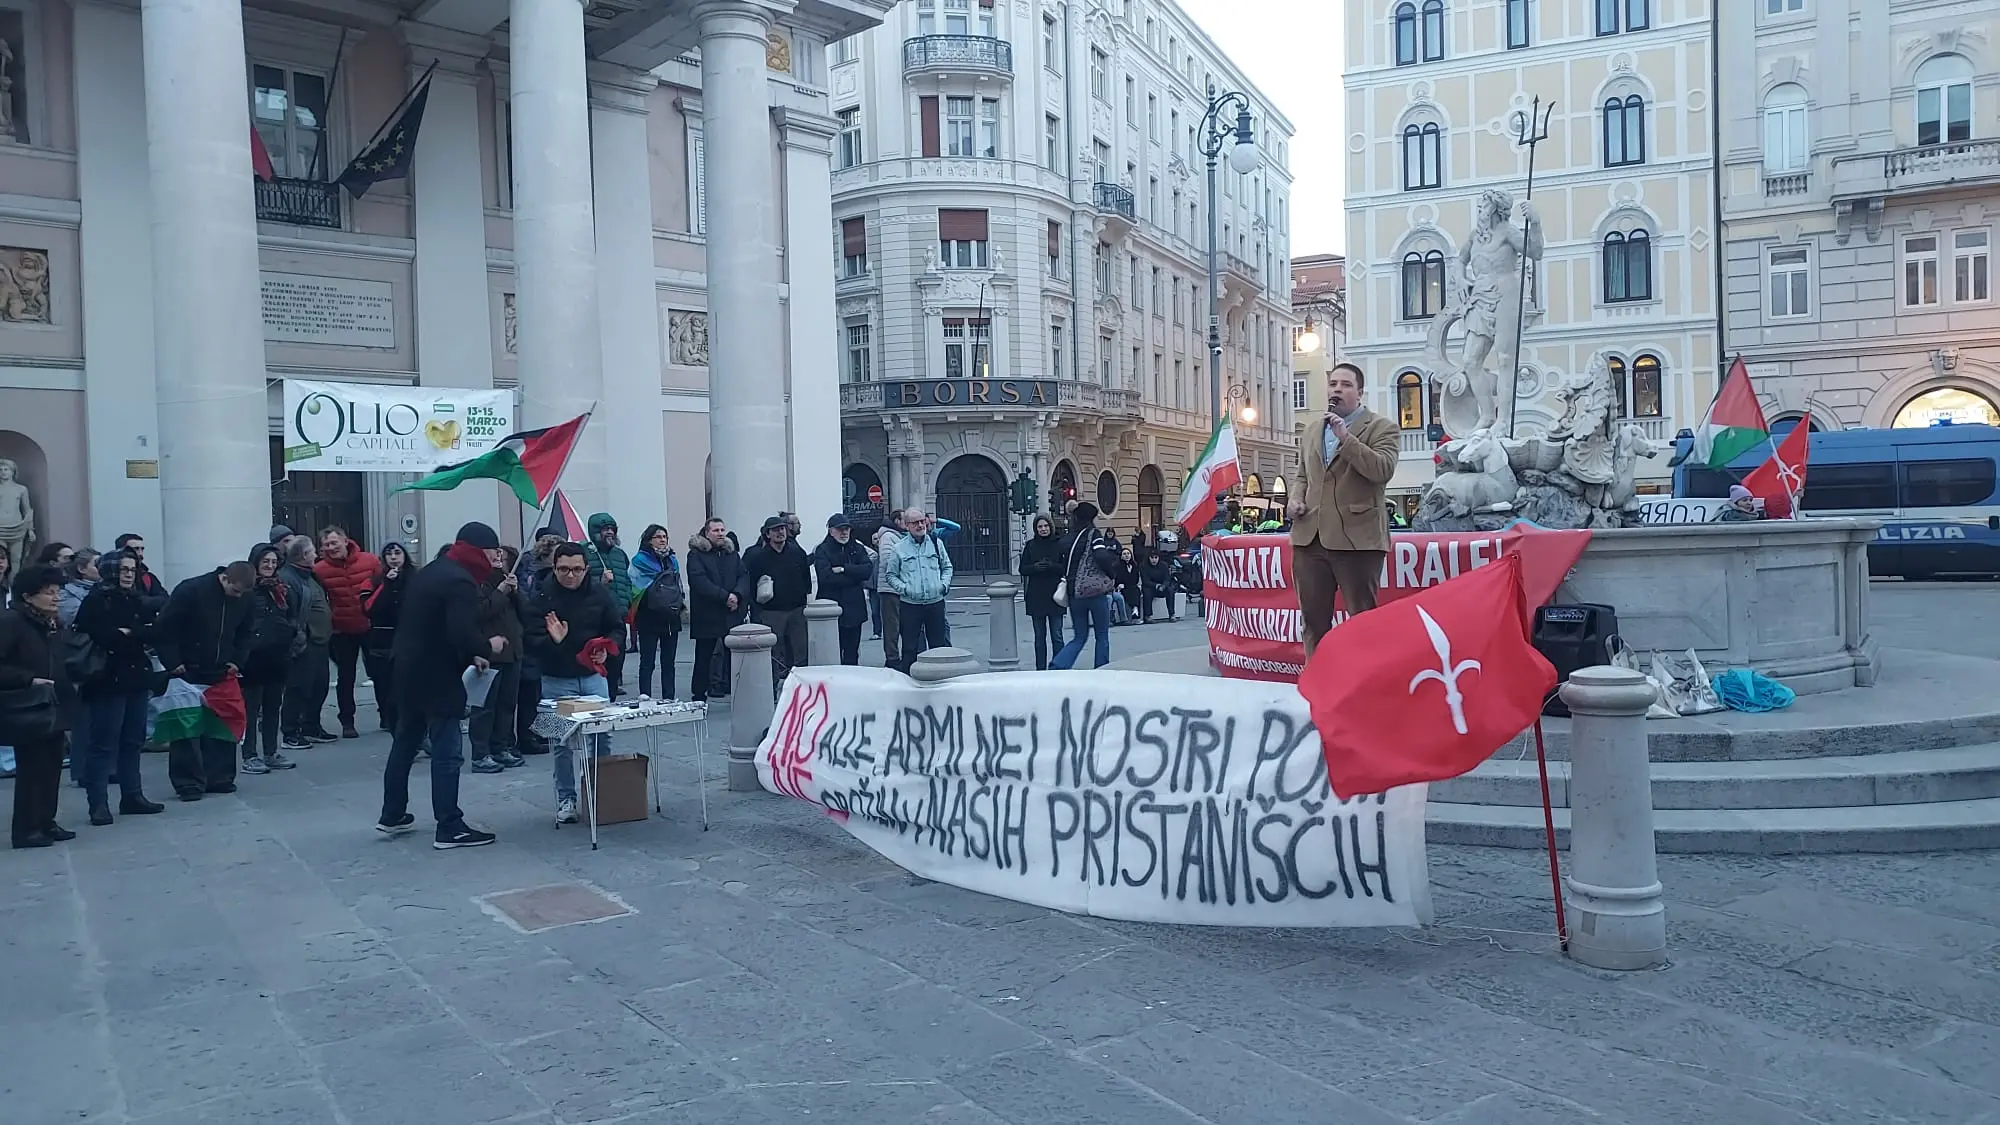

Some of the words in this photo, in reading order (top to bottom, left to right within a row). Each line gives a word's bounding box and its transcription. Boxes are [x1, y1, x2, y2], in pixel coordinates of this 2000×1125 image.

[900, 381, 1047, 405] BORSA
[467, 406, 494, 416] 13-15
[295, 391, 420, 448] OLIO
[466, 416, 507, 426] MARZO
[466, 426, 495, 436] 2026
[346, 437, 417, 450] CAPITALE
[1876, 526, 1966, 540] LIZIA
[767, 681, 829, 767] NO
[884, 704, 965, 778] ARMI
[972, 711, 1038, 782] NEI
[1056, 697, 1236, 795] NOSTRI
[926, 771, 1030, 877] NAŠIH
[1046, 788, 1396, 907] PRISTANIŠČIH
